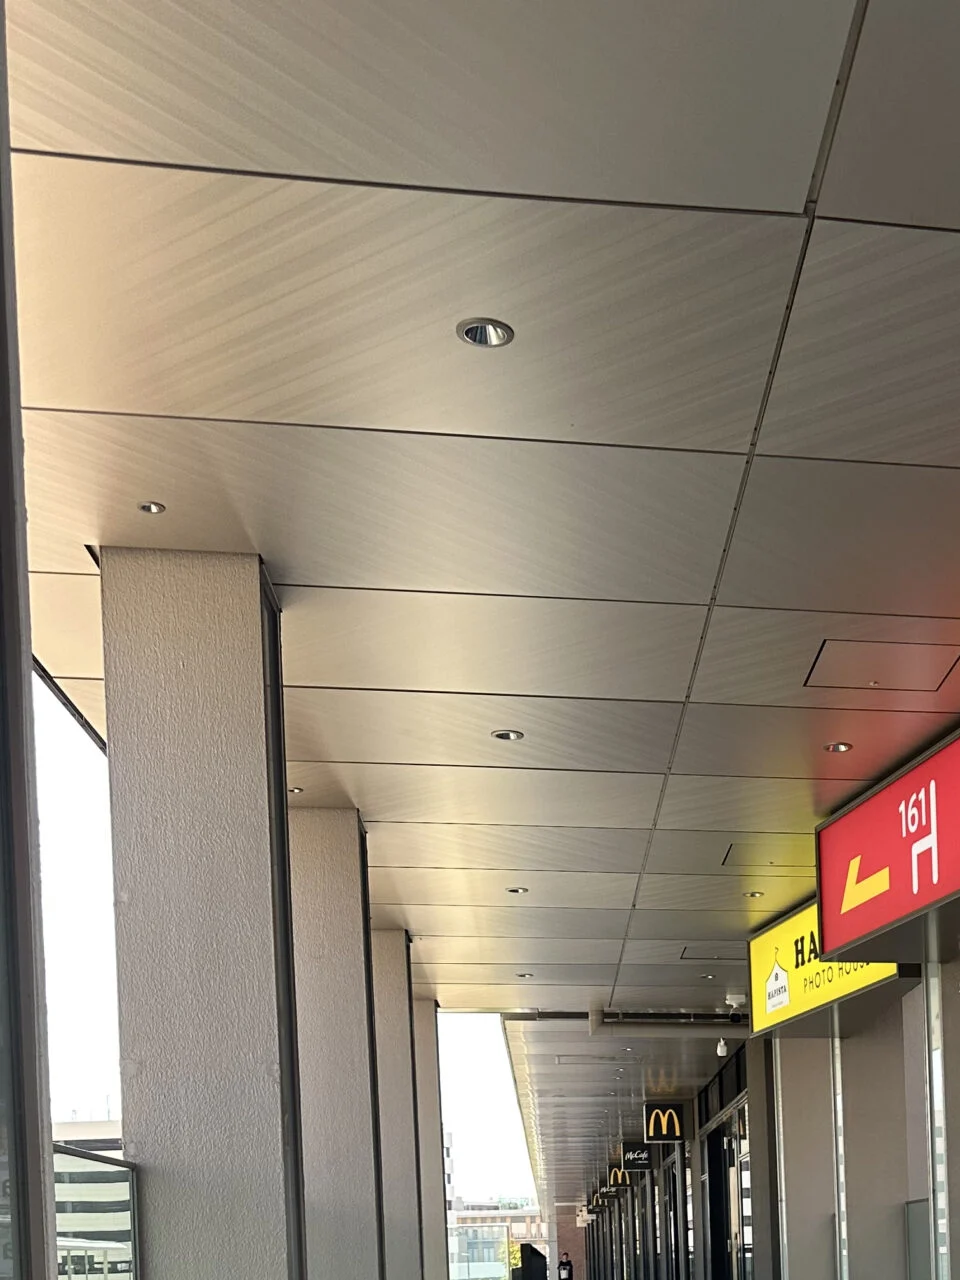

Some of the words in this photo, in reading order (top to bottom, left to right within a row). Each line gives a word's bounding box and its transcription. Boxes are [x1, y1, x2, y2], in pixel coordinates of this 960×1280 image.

[803, 966, 834, 994] PHOTO
[838, 962, 870, 979] HOU
[767, 986, 787, 1001] HAPISTA
